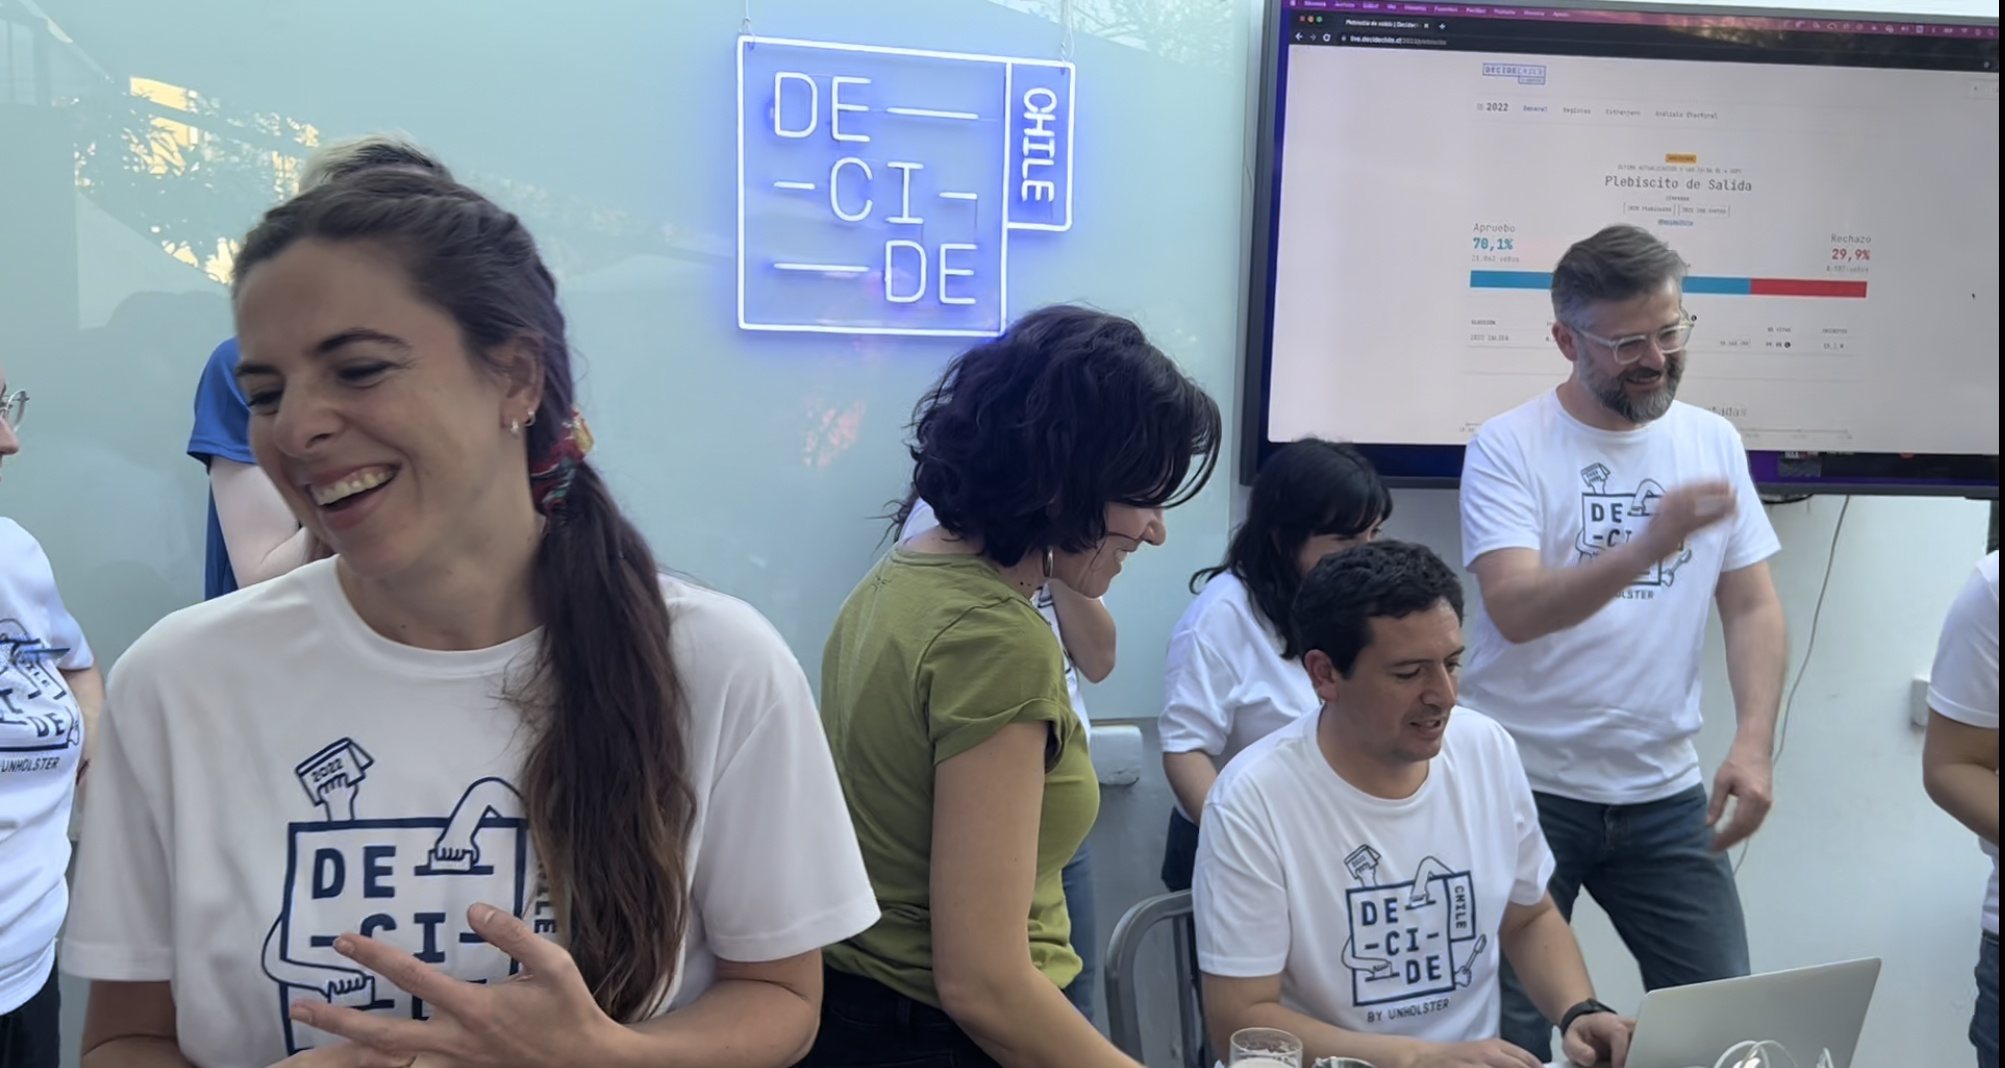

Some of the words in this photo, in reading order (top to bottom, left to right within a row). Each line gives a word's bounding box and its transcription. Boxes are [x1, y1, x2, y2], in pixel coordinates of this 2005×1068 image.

[1486, 102, 1509, 113] 2022
[1021, 87, 1058, 203] CHILE
[1605, 175, 1679, 190] Plebiscito
[1686, 177, 1701, 190] de
[1708, 179, 1752, 192] Salida
[1473, 223, 1516, 234] Apruebo
[1831, 233, 1872, 244] Rechazo
[1832, 248, 1871, 262] 29,9%
[1, 756, 60, 773] UNHOLSTER
[311, 757, 344, 782] 2022
[1454, 885, 1468, 929] CHILE
[1367, 1011, 1382, 1023] BY
[1388, 998, 1450, 1020] UNHOLSTER
